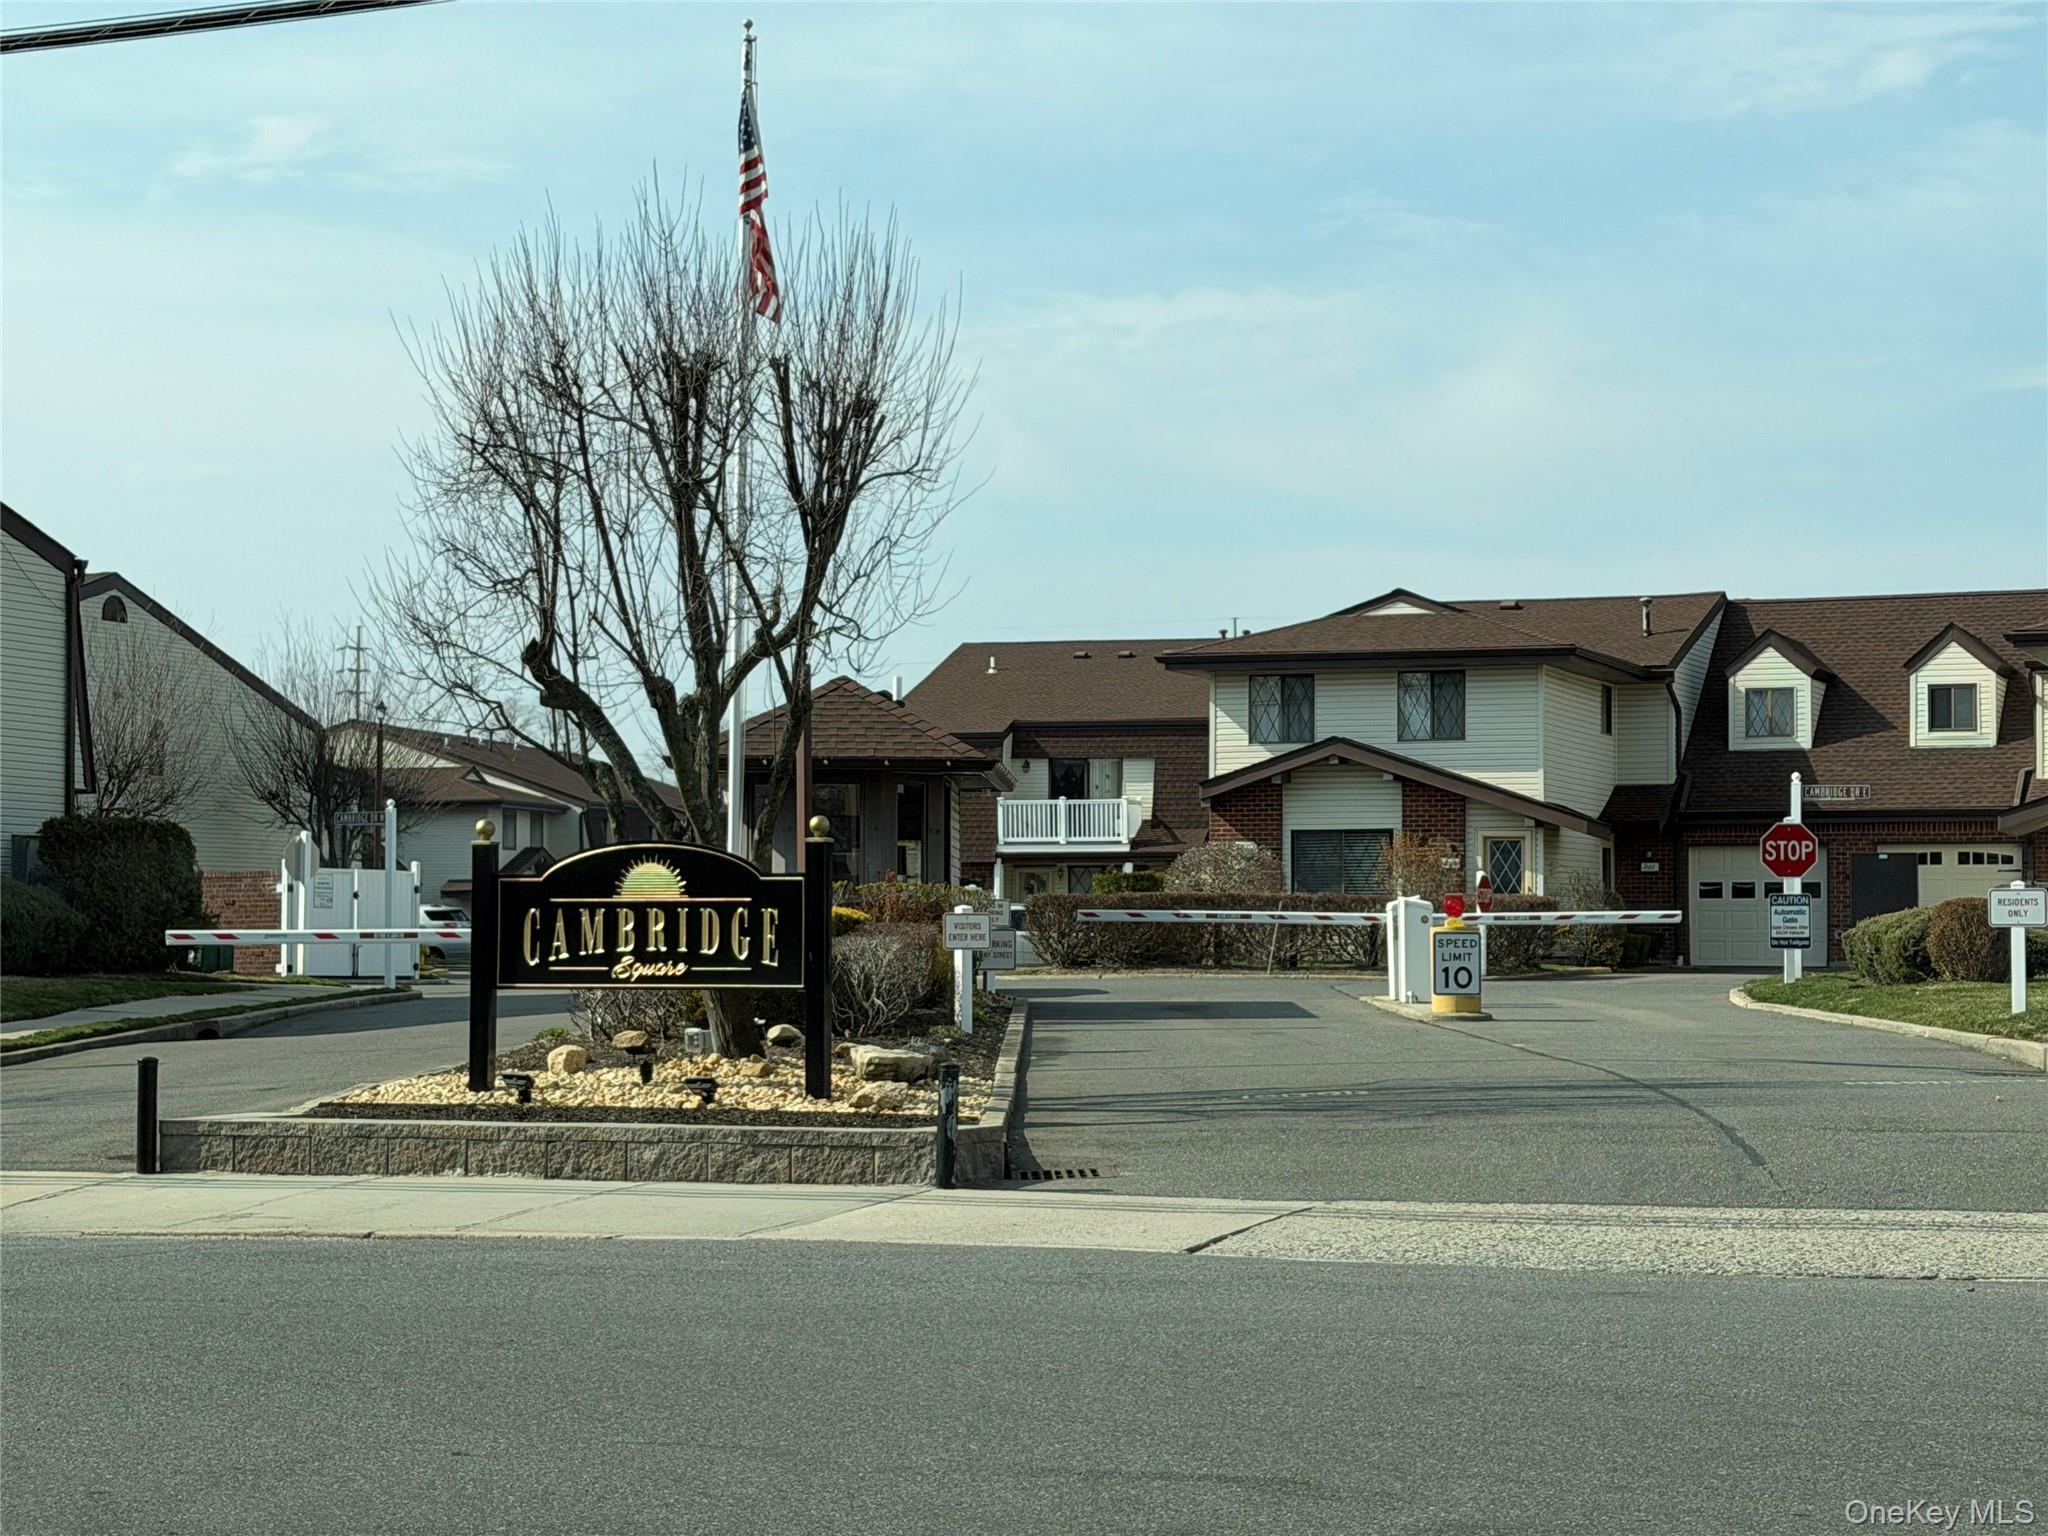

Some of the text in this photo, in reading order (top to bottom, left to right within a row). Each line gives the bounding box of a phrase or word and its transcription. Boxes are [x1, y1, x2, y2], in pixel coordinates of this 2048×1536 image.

[1804, 787, 1868, 798] CAMBRIDGE DR E
[1765, 840, 1814, 861] STOP
[1771, 896, 1809, 905] CAUTION
[1997, 898, 2039, 906] RESIDENTS
[2008, 909, 2028, 917] ONLY
[954, 922, 982, 930] VISITORS
[523, 907, 779, 967] CAMBRIDGE
[948, 933, 987, 941] ENTER HERE
[1437, 938, 1478, 949] SPEED
[1441, 952, 1473, 962] LIMIT
[610, 955, 688, 982] Square
[1441, 966, 1473, 989] 10
